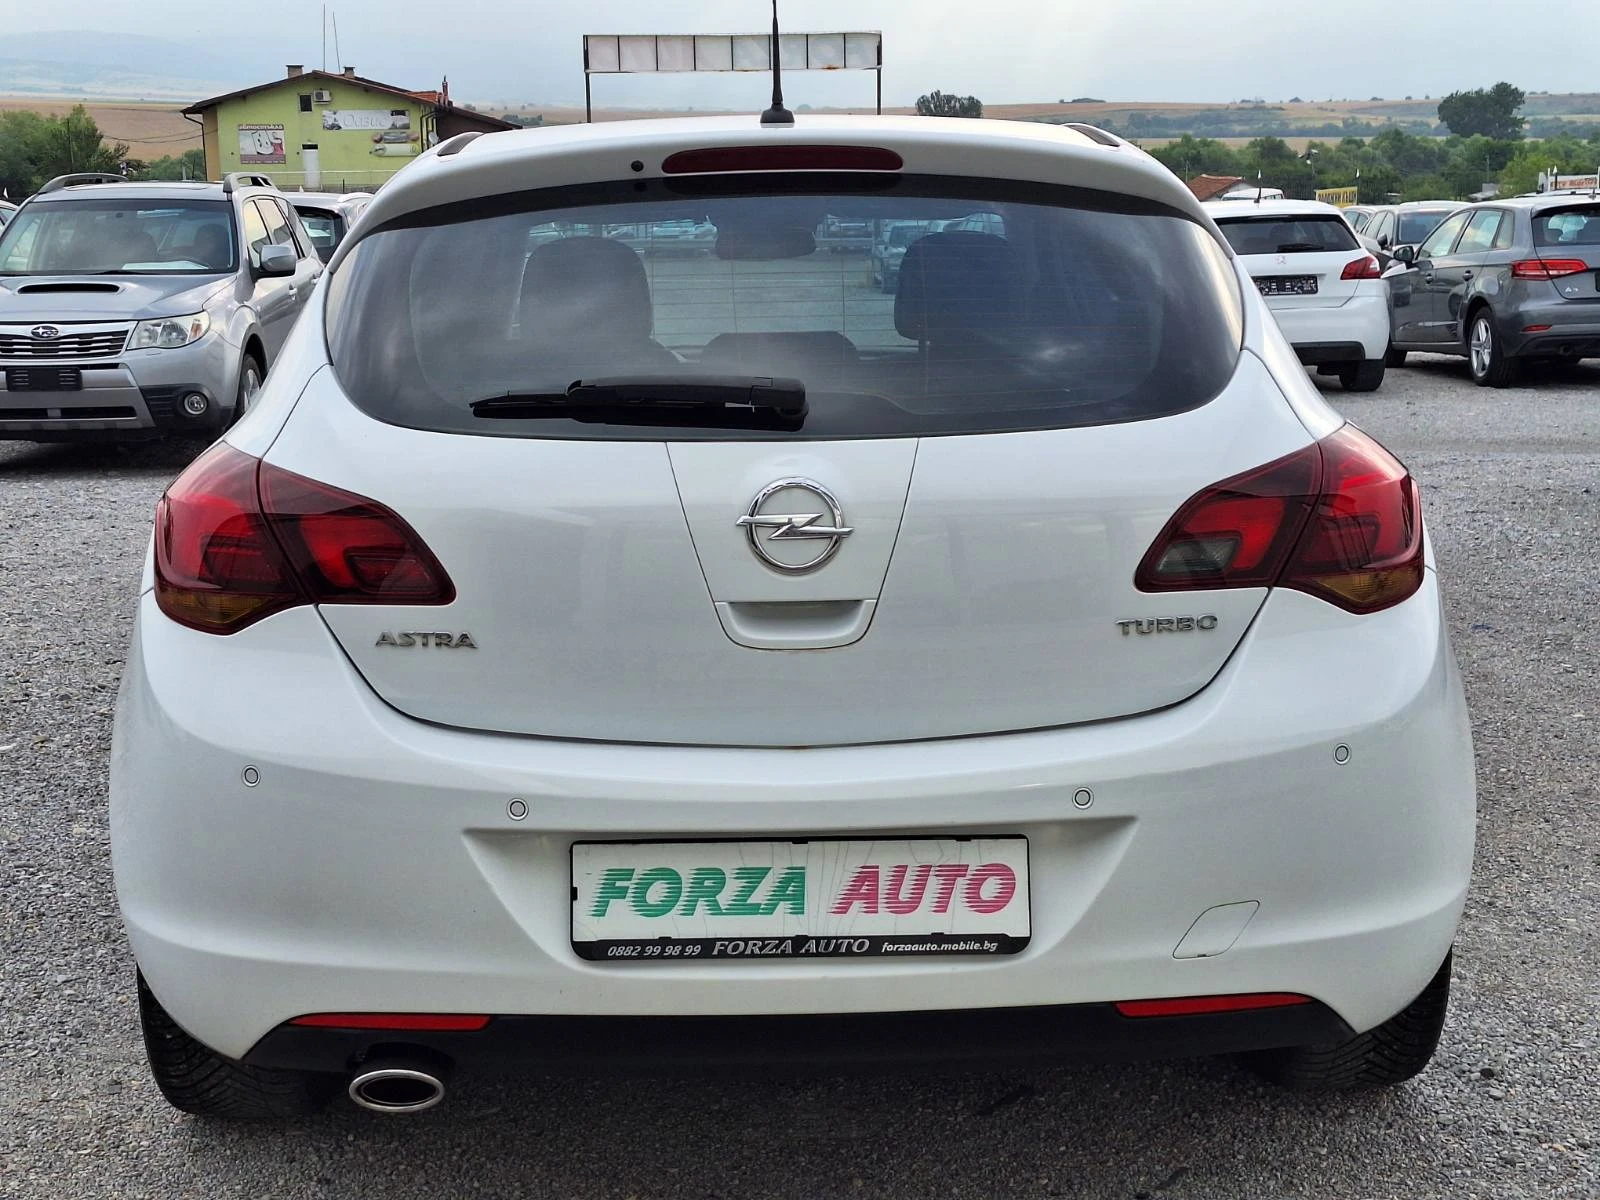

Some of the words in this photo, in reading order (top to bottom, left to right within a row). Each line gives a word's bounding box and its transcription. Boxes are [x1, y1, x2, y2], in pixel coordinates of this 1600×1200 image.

[1115, 614, 1218, 636] TURBO
[375, 631, 478, 649] ASTRA
[586, 866, 806, 918] FORZA
[826, 862, 1016, 915] AUTO
[607, 945, 641, 957] 0882
[643, 945, 661, 956] 99
[663, 945, 682, 956] 98
[683, 944, 702, 956] 99
[712, 938, 793, 955] FORZA
[799, 938, 870, 954] AUTO
[881, 940, 999, 952] forzaauto.mobile.bg
